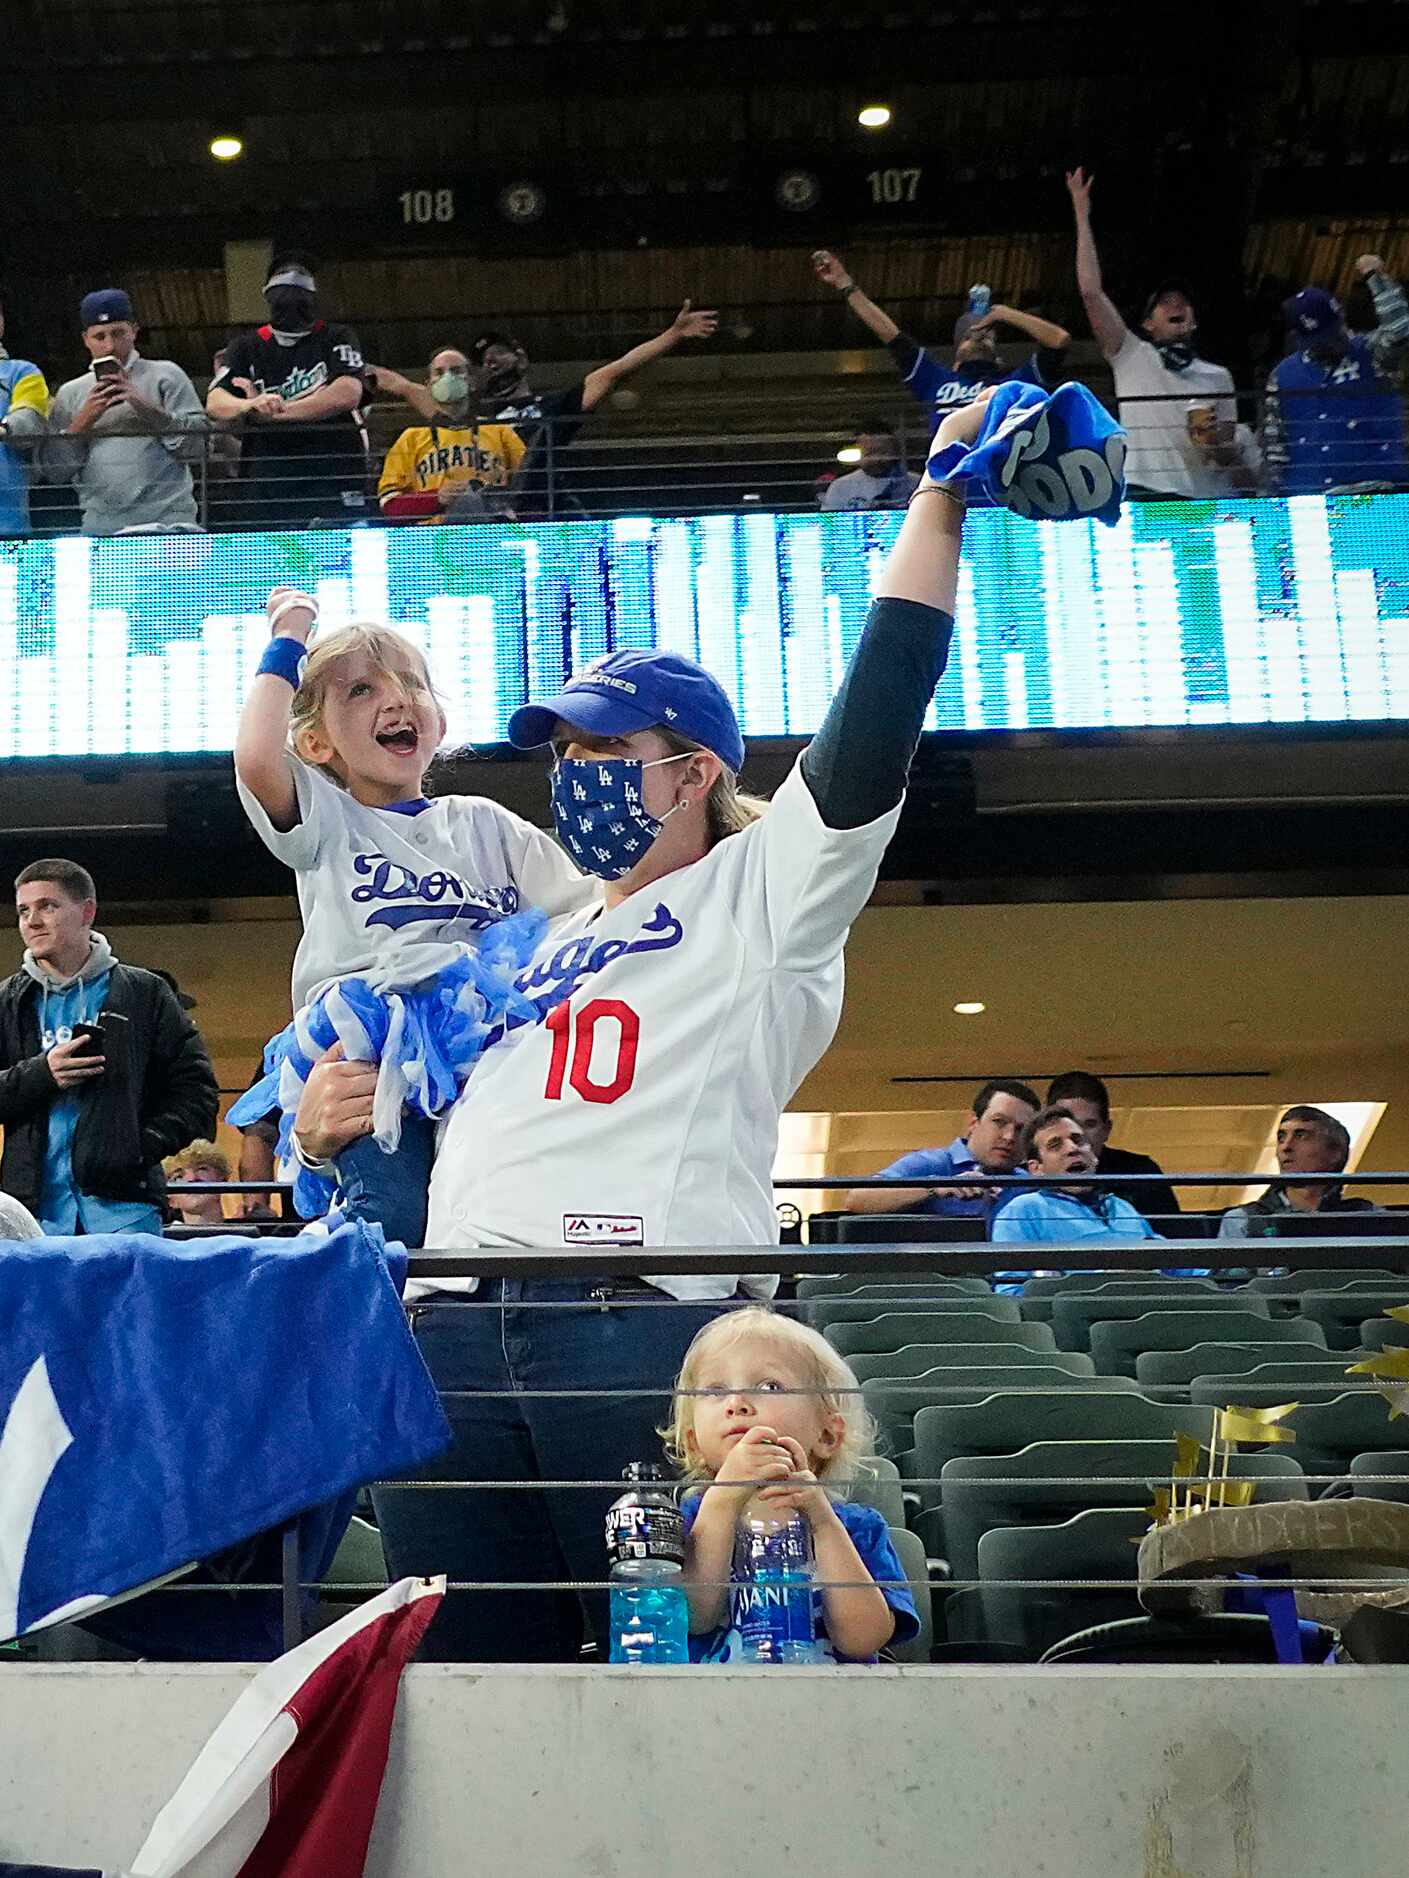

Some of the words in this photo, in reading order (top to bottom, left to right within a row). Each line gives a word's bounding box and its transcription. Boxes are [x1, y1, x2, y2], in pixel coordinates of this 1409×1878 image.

[866, 169, 922, 203] 107
[399, 190, 454, 223] 108
[598, 765, 612, 786] LA
[572, 779, 586, 800] LA
[624, 781, 638, 802] LA
[544, 998, 640, 1105] 10
